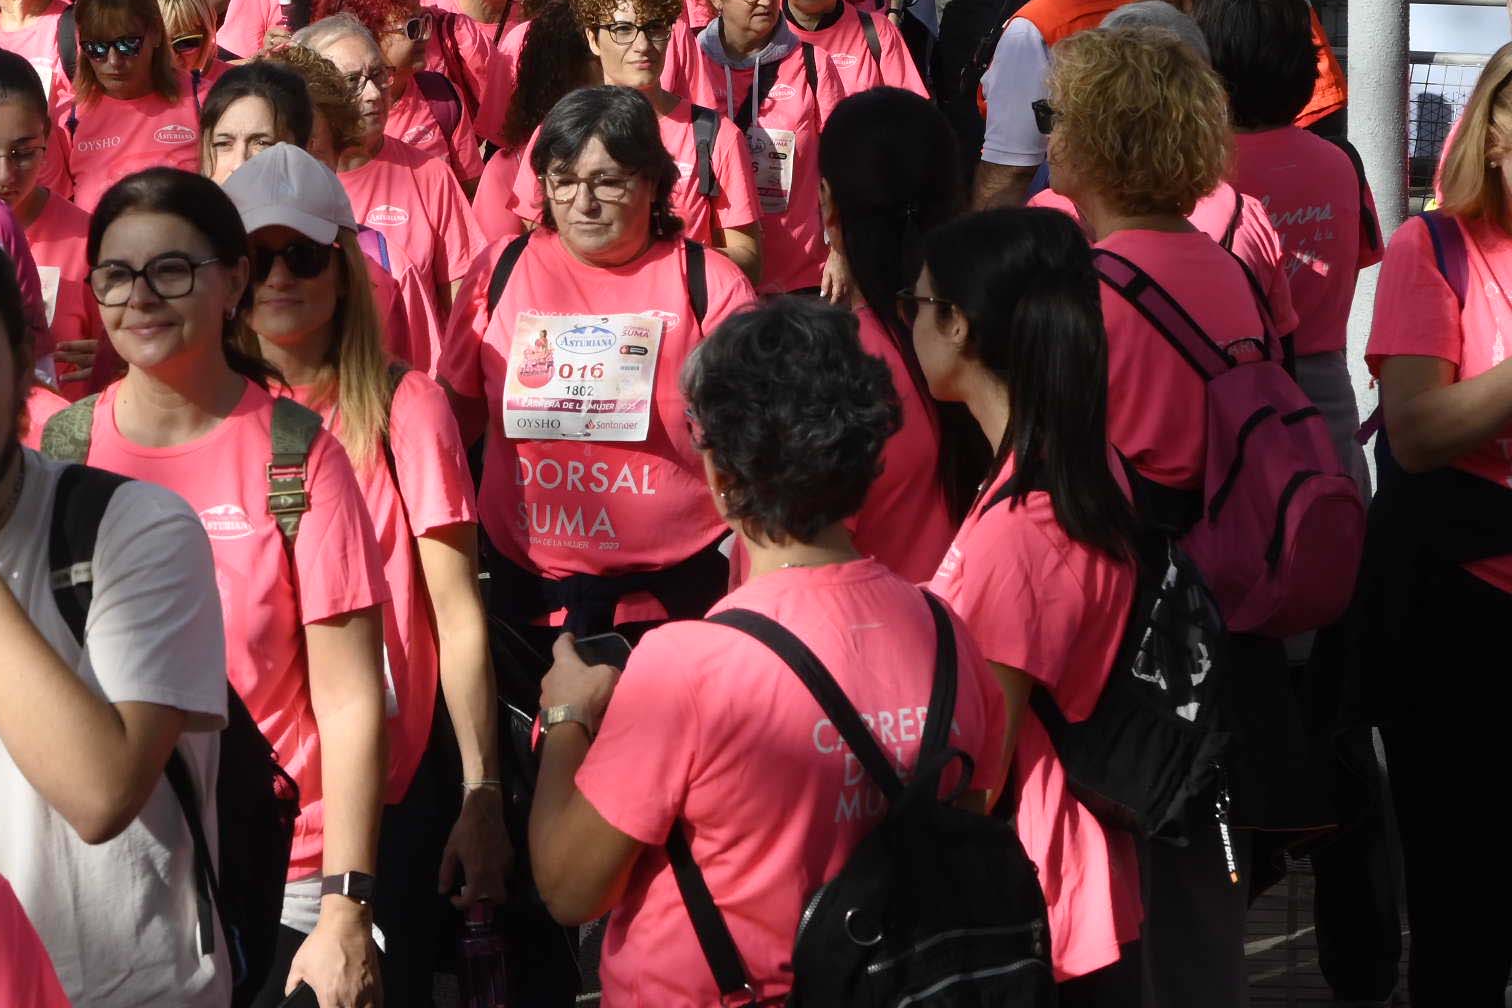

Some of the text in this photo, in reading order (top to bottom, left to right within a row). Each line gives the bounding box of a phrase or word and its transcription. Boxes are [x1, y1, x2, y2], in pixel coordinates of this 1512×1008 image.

[77, 135, 121, 154] OYSHO
[560, 335, 612, 347] ASTURIANA
[559, 362, 604, 380] 016
[562, 401, 575, 409] DE
[590, 401, 616, 410] MUJER
[517, 417, 638, 430] OYSHO Santander
[516, 456, 656, 494] DORSAL
[516, 503, 616, 538] SUMA
